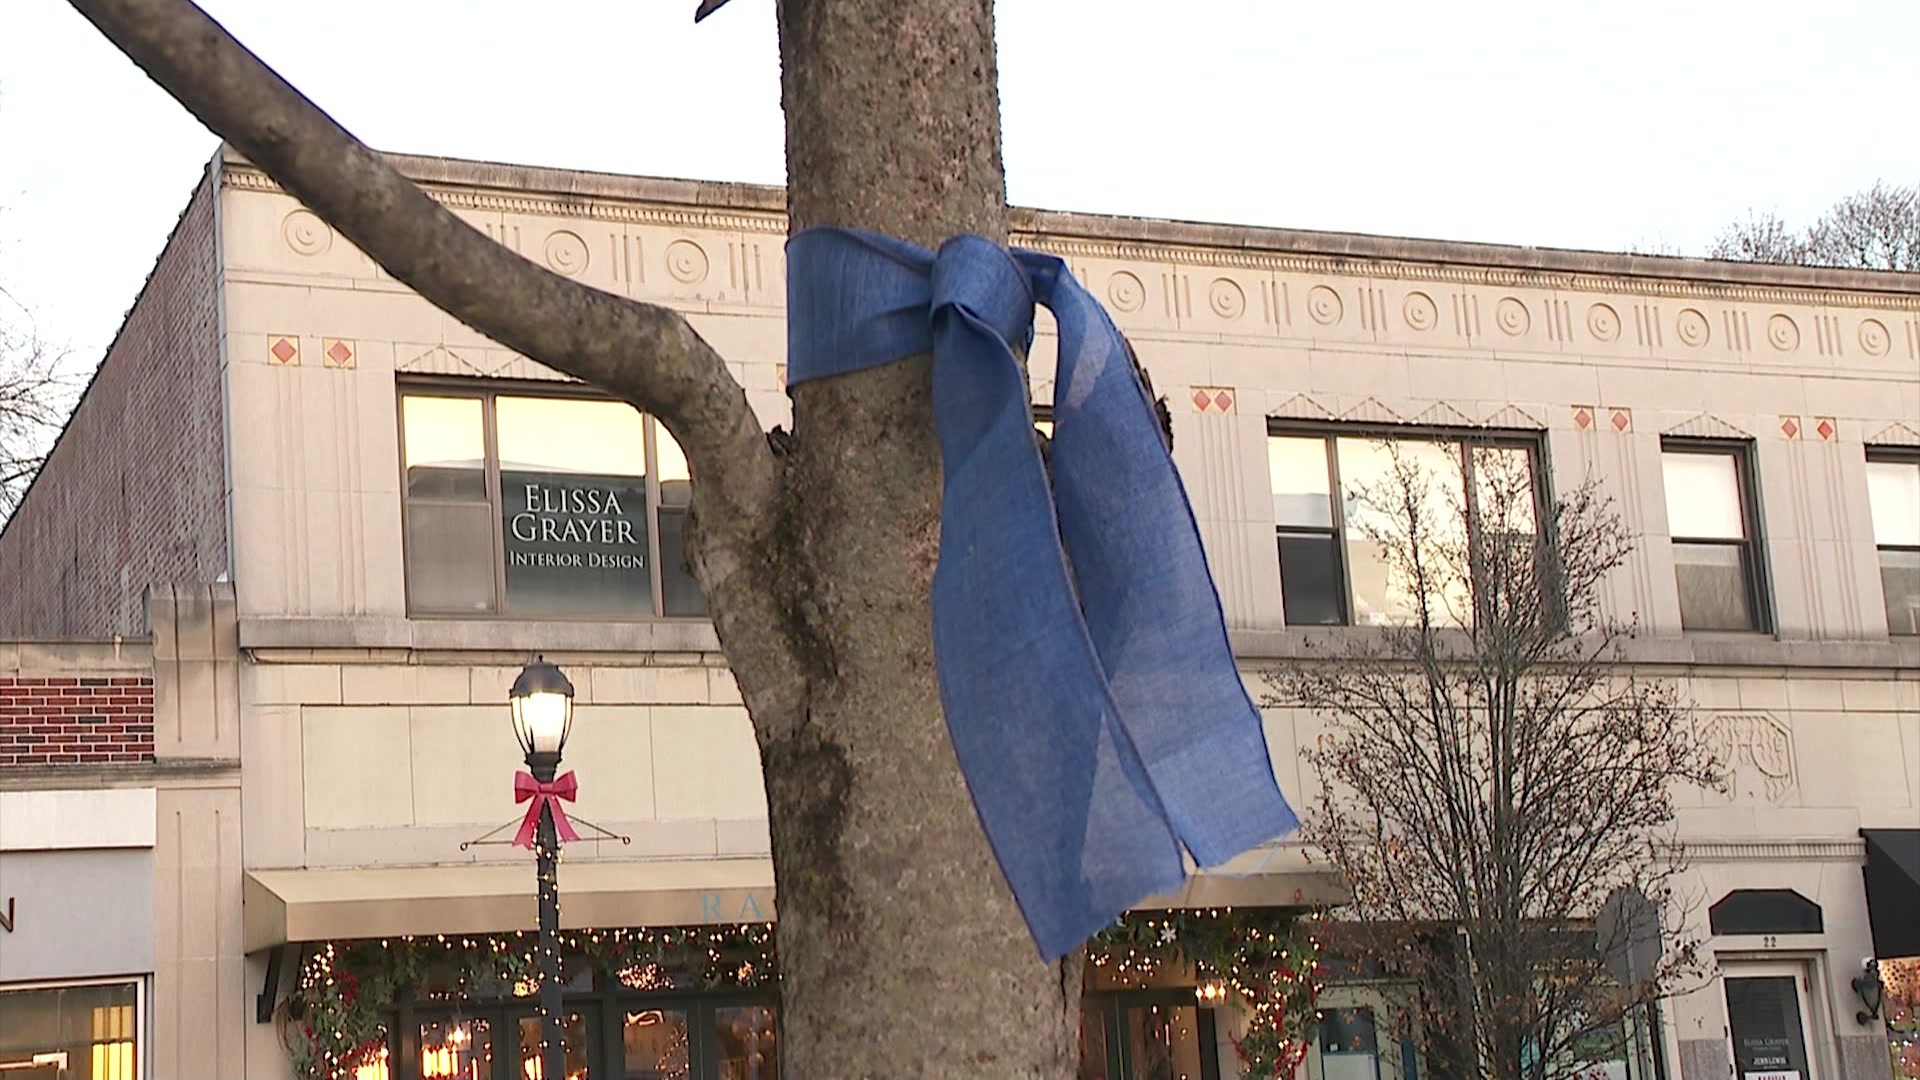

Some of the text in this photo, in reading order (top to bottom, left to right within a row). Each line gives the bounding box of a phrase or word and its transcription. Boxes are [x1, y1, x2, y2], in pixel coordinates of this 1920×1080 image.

[525, 484, 623, 515] ELISSA
[511, 513, 638, 544] GRAYER
[509, 551, 645, 569] INTERIOR DESIGN
[1763, 936, 1776, 948] 22
